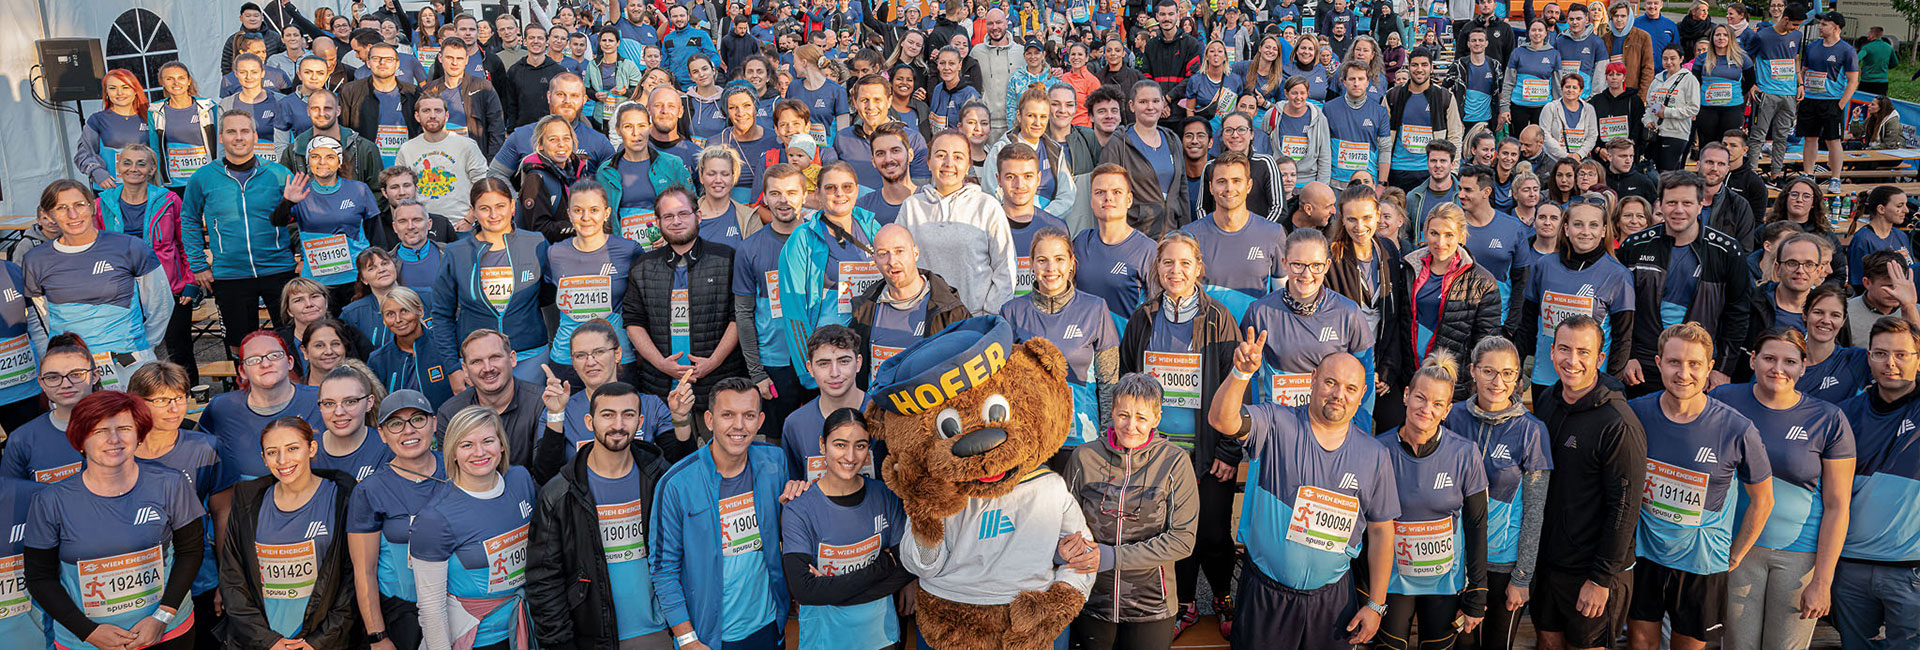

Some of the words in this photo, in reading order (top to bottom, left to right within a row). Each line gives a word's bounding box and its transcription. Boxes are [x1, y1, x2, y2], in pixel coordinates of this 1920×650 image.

[180, 157, 208, 168] 19117C
[318, 248, 348, 261] 19119C
[574, 292, 608, 305] 22141B
[1568, 298, 1590, 306] ENERGIE
[1, 350, 33, 371] 22129C
[888, 342, 1007, 416] HOFER
[1162, 372, 1199, 388] 19008C
[54, 468, 74, 478] WIEN
[1658, 466, 1676, 476] WIEN
[1676, 472, 1704, 483] ENERGIE
[1316, 492, 1332, 500] WIEN
[1332, 496, 1357, 508] ENERGIE
[1659, 484, 1701, 506] 19114A
[725, 501, 742, 509] WIEN
[1652, 507, 1672, 518] spusu
[1315, 510, 1352, 532] 19009A
[1426, 522, 1450, 532] ENERGIE
[503, 533, 520, 544] WIEN
[1305, 536, 1326, 546] spusu
[279, 546, 310, 554] ENERGIE
[732, 544, 753, 554] spusu
[856, 540, 878, 554] ENERGIE
[1414, 537, 1452, 556] 19005C
[102, 559, 124, 570] WIEN
[125, 551, 158, 564] ENERGIE
[266, 562, 313, 578] 19142C
[109, 568, 161, 593] 19246A
[107, 601, 134, 613] spusu
